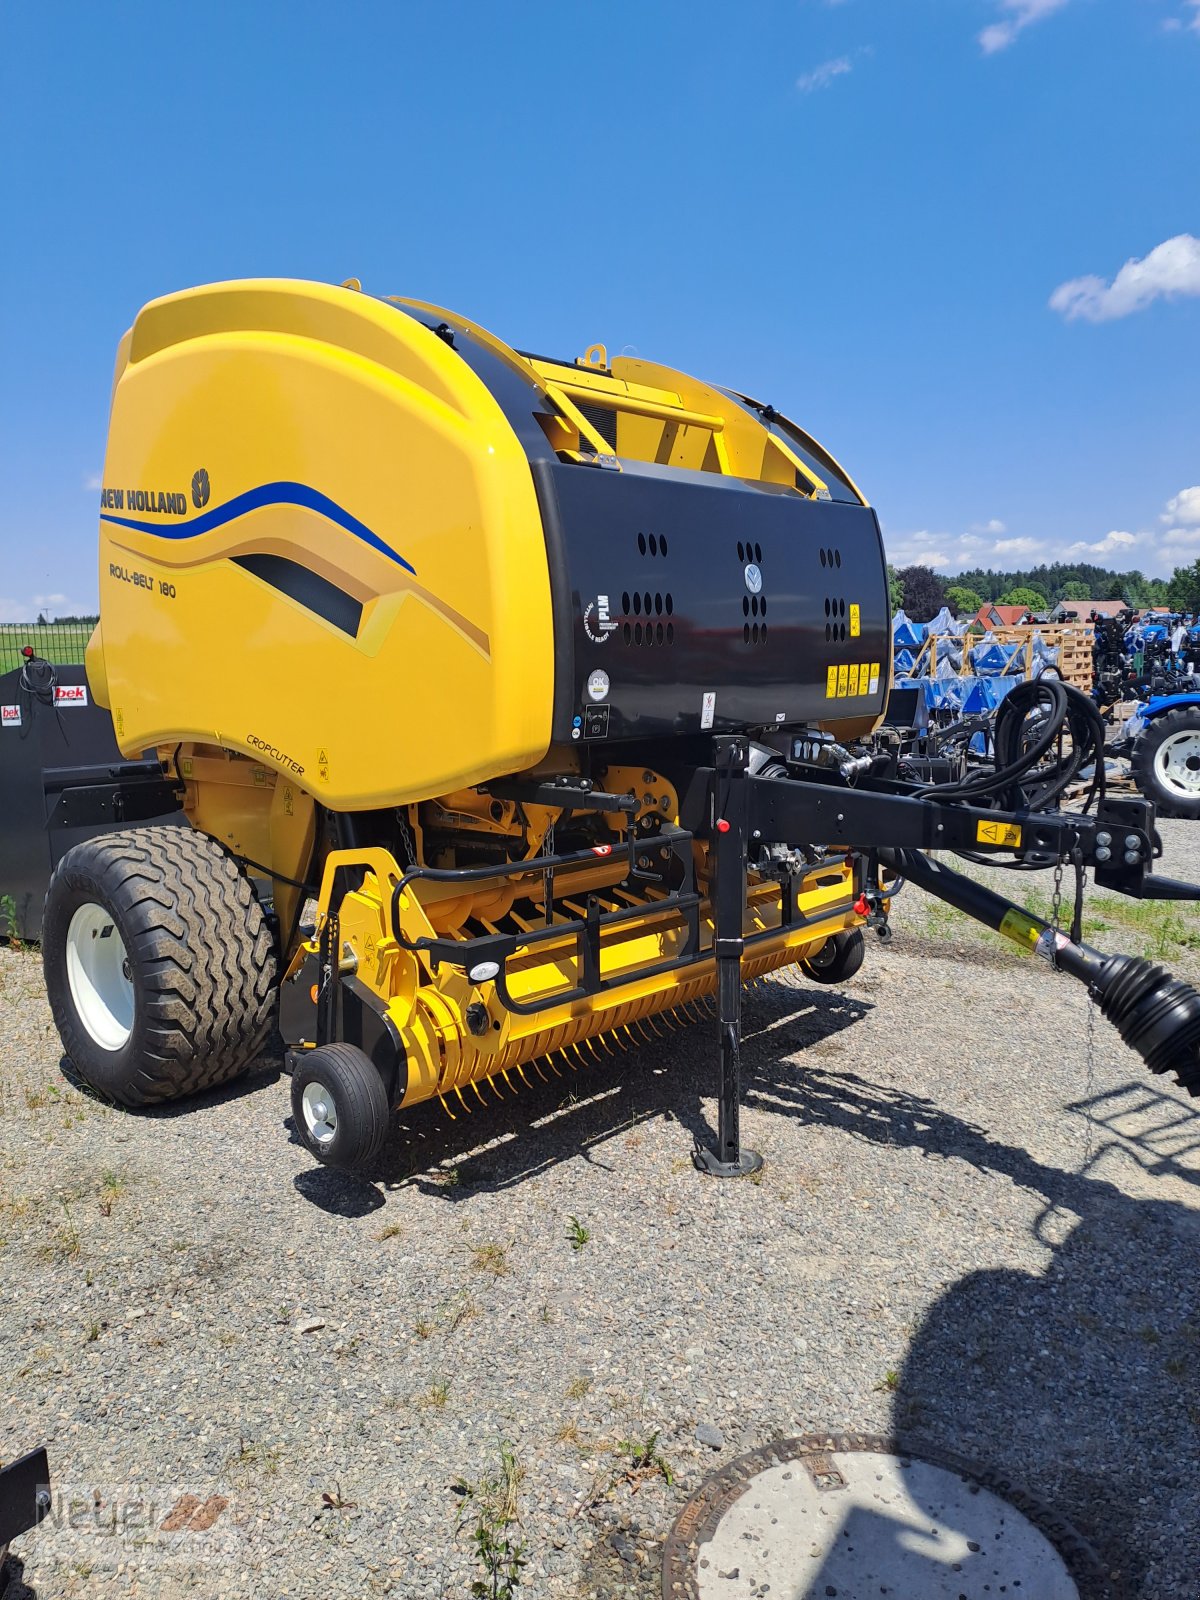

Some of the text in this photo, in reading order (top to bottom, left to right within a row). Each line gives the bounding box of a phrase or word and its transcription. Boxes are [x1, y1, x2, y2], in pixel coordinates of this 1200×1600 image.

[100, 488, 188, 516] NEW HOLLAND
[109, 563, 177, 599] ROLL-BELT 180
[597, 594, 610, 621] PLM
[55, 687, 85, 698] bek
[592, 677, 605, 687] OK
[3, 706, 19, 718] bek
[246, 734, 305, 777] CROPCUTTER
[677, 1484, 718, 1536] HYDROEC
[704, 1487, 742, 1533] HYDROTEC
